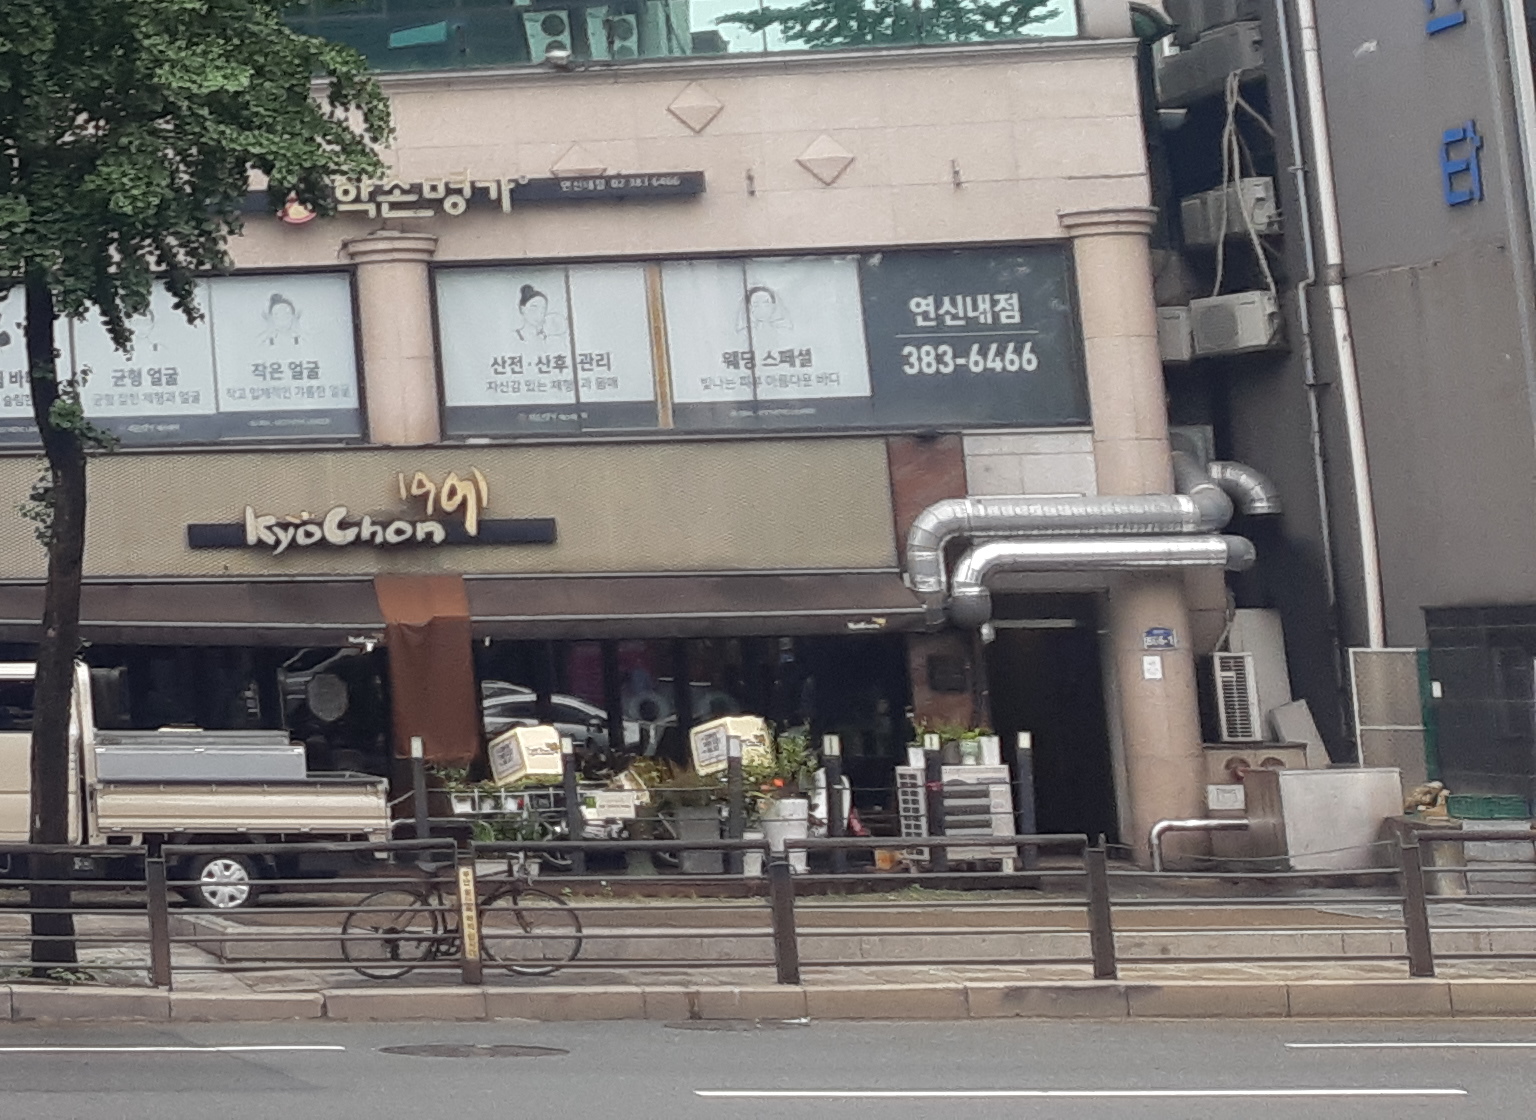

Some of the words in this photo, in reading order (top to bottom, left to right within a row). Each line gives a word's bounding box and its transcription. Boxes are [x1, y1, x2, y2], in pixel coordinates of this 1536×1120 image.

[332, 174, 516, 218] 약손명가
[909, 293, 1022, 327] 연신내점
[252, 362, 284, 381] 작은
[289, 360, 320, 380] 얼굴
[578, 352, 612, 371] 관리
[722, 350, 756, 370] 웨딩
[762, 348, 812, 368] 스페셜
[901, 342, 1039, 376] 383-6466
[147, 367, 178, 387] 얼굴
[398, 466, 488, 537] 1991
